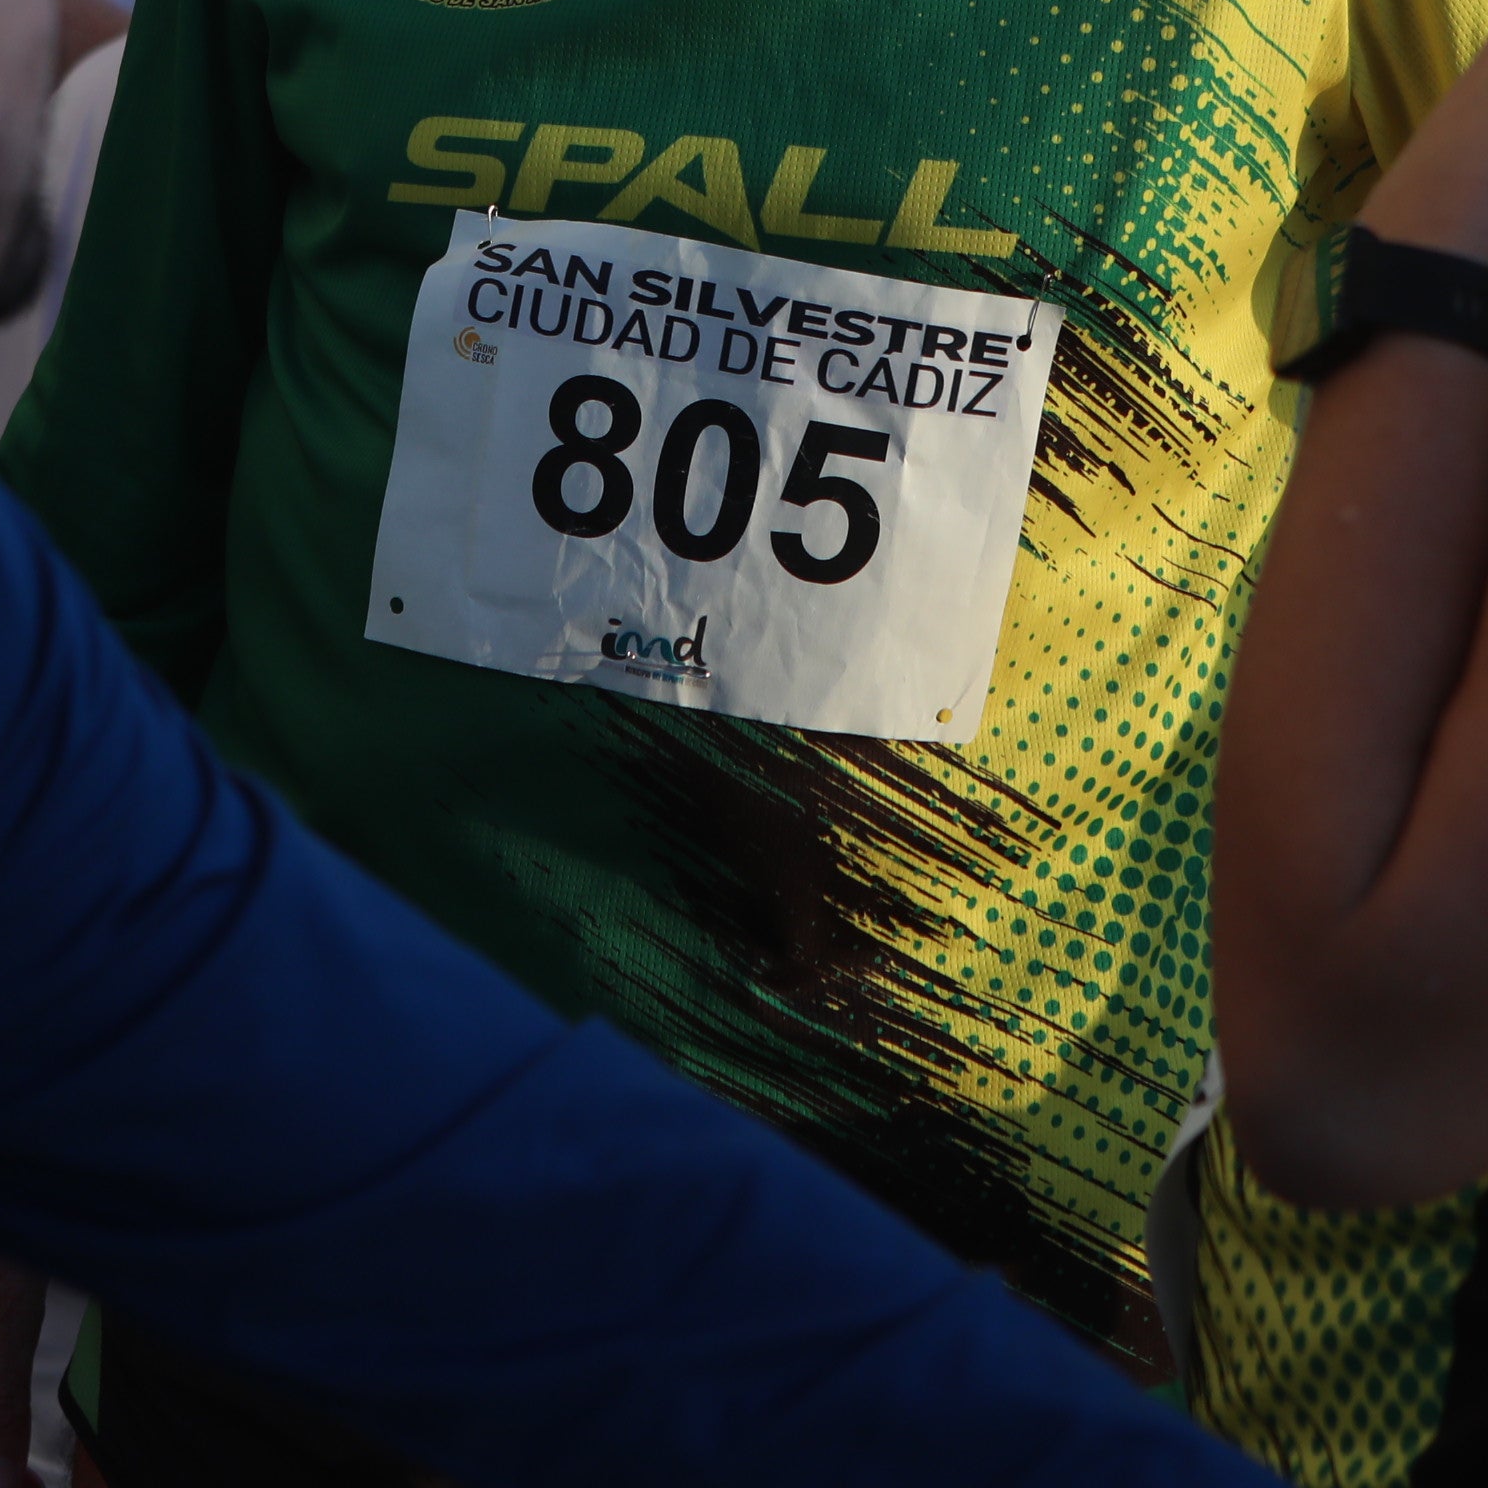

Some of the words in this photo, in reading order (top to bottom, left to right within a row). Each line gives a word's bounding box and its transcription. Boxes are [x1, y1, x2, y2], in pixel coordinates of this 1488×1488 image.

[388, 116, 1020, 258] SPALL
[467, 277, 701, 363] CIUDAD
[718, 327, 801, 386] DE
[471, 353, 495, 366] SESCA
[472, 343, 498, 356] CRONO
[474, 243, 612, 296] SAN
[628, 269, 1013, 368] SILVESTRE
[531, 374, 891, 585] 805
